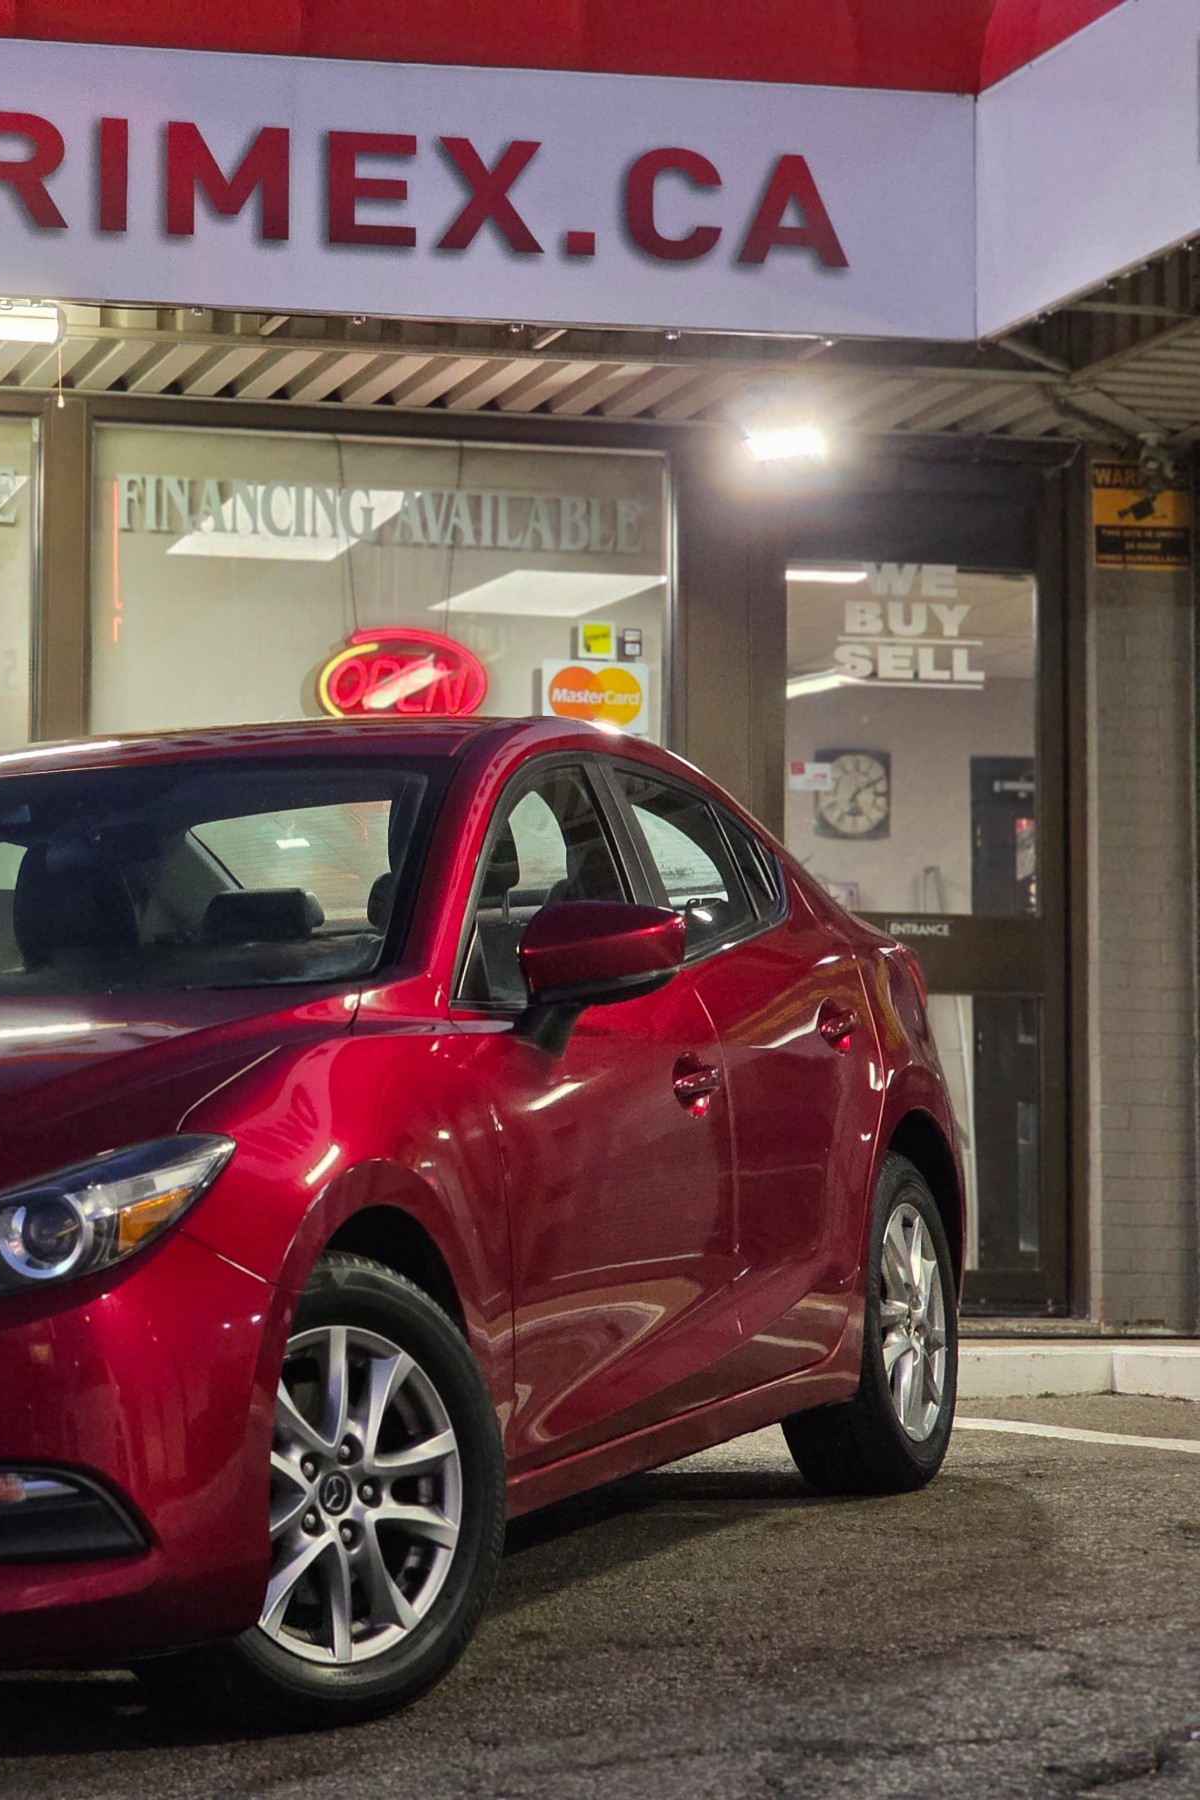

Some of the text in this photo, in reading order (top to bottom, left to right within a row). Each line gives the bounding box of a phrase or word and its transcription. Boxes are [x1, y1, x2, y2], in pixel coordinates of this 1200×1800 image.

[115, 473, 645, 554] FINANCING AVAILABLE
[861, 562, 958, 597] WE
[844, 601, 972, 637] BUY
[834, 644, 985, 681] SELL
[552, 687, 641, 705] MasterCard
[890, 922, 950, 937] ENTRANCE
